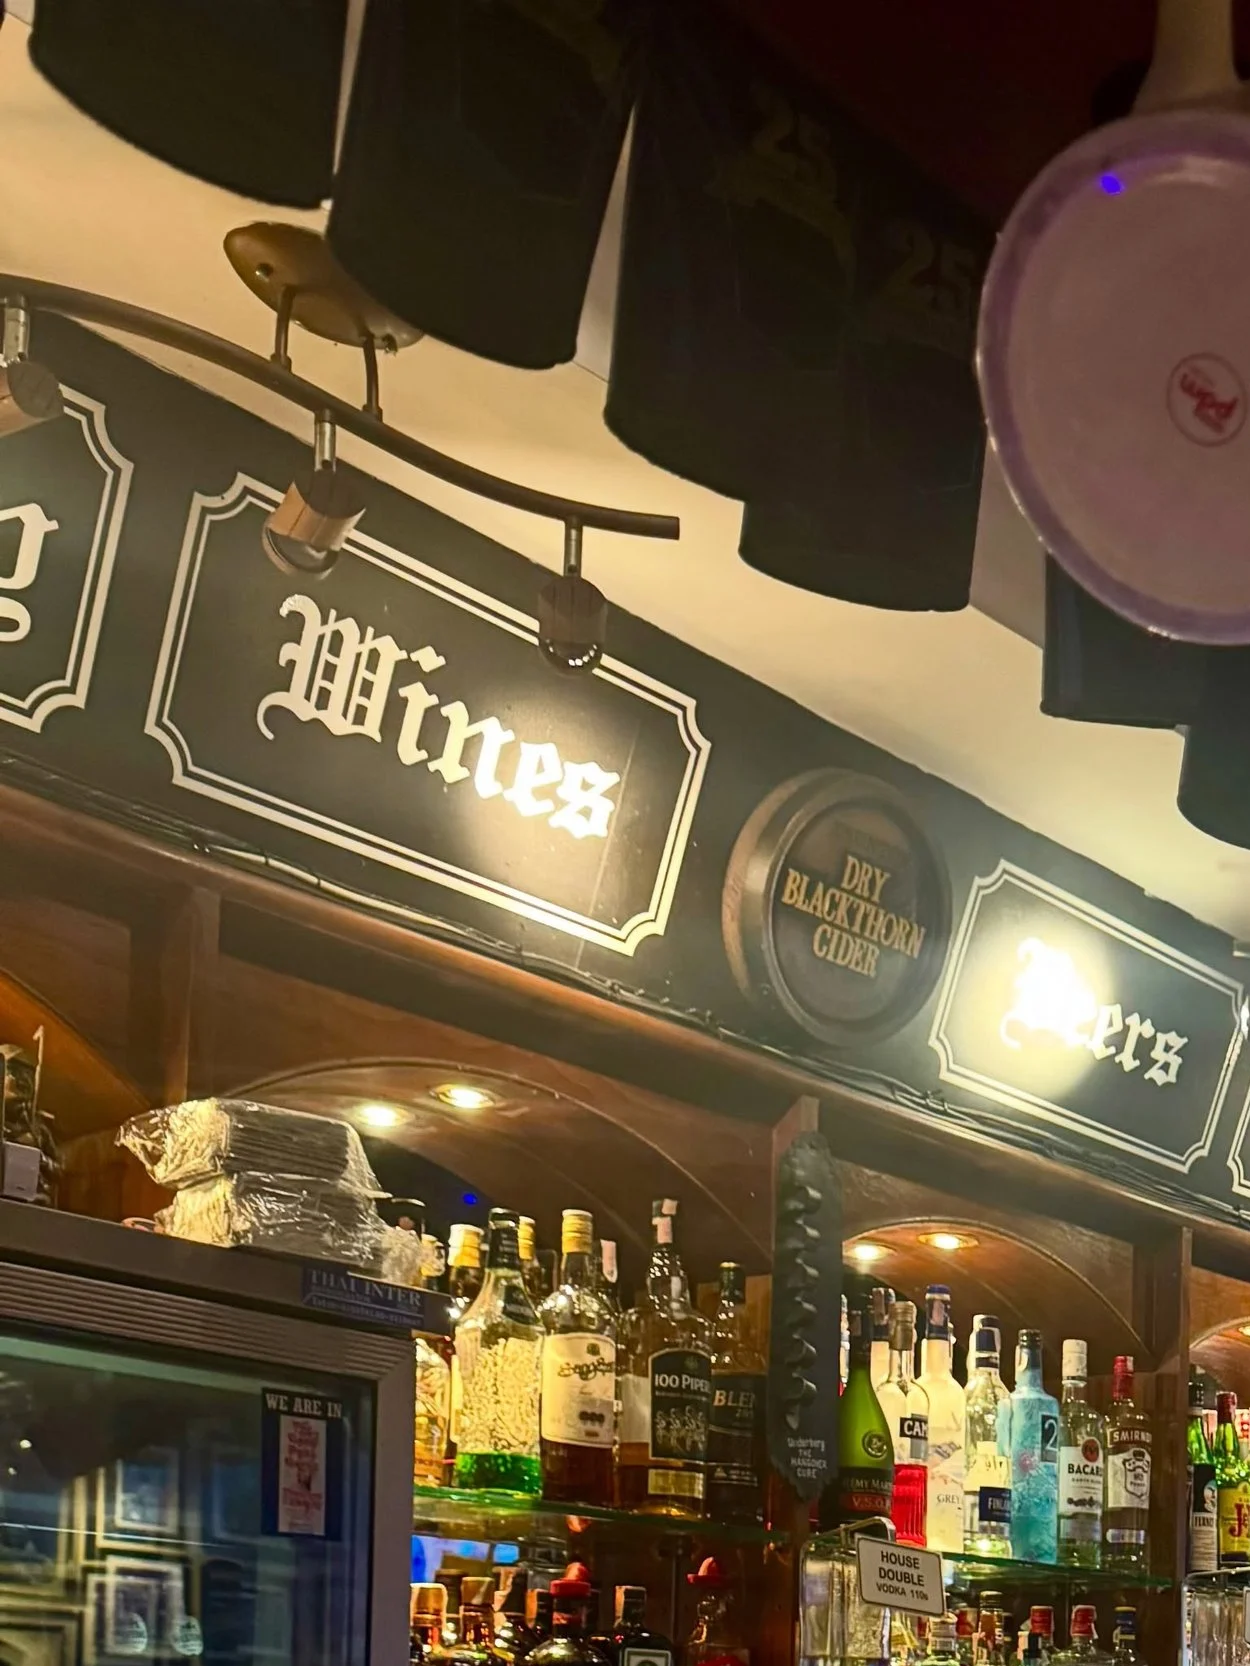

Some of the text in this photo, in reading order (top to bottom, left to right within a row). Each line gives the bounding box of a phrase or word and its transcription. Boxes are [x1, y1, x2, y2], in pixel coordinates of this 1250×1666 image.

[256, 594, 620, 839] Wines
[842, 856, 890, 901] DRY
[781, 867, 924, 959] BLACKTHORN
[812, 925, 880, 979] CIDER
[309, 1268, 359, 1294] THAI
[364, 1280, 422, 1307] INTER
[654, 1374, 679, 1390] 100
[265, 1392, 343, 1419] WE ARE IN
[881, 1551, 920, 1570] HOUSE
[876, 1582, 907, 1597] VODKA
[879, 1568, 924, 1587] DOUBLE
